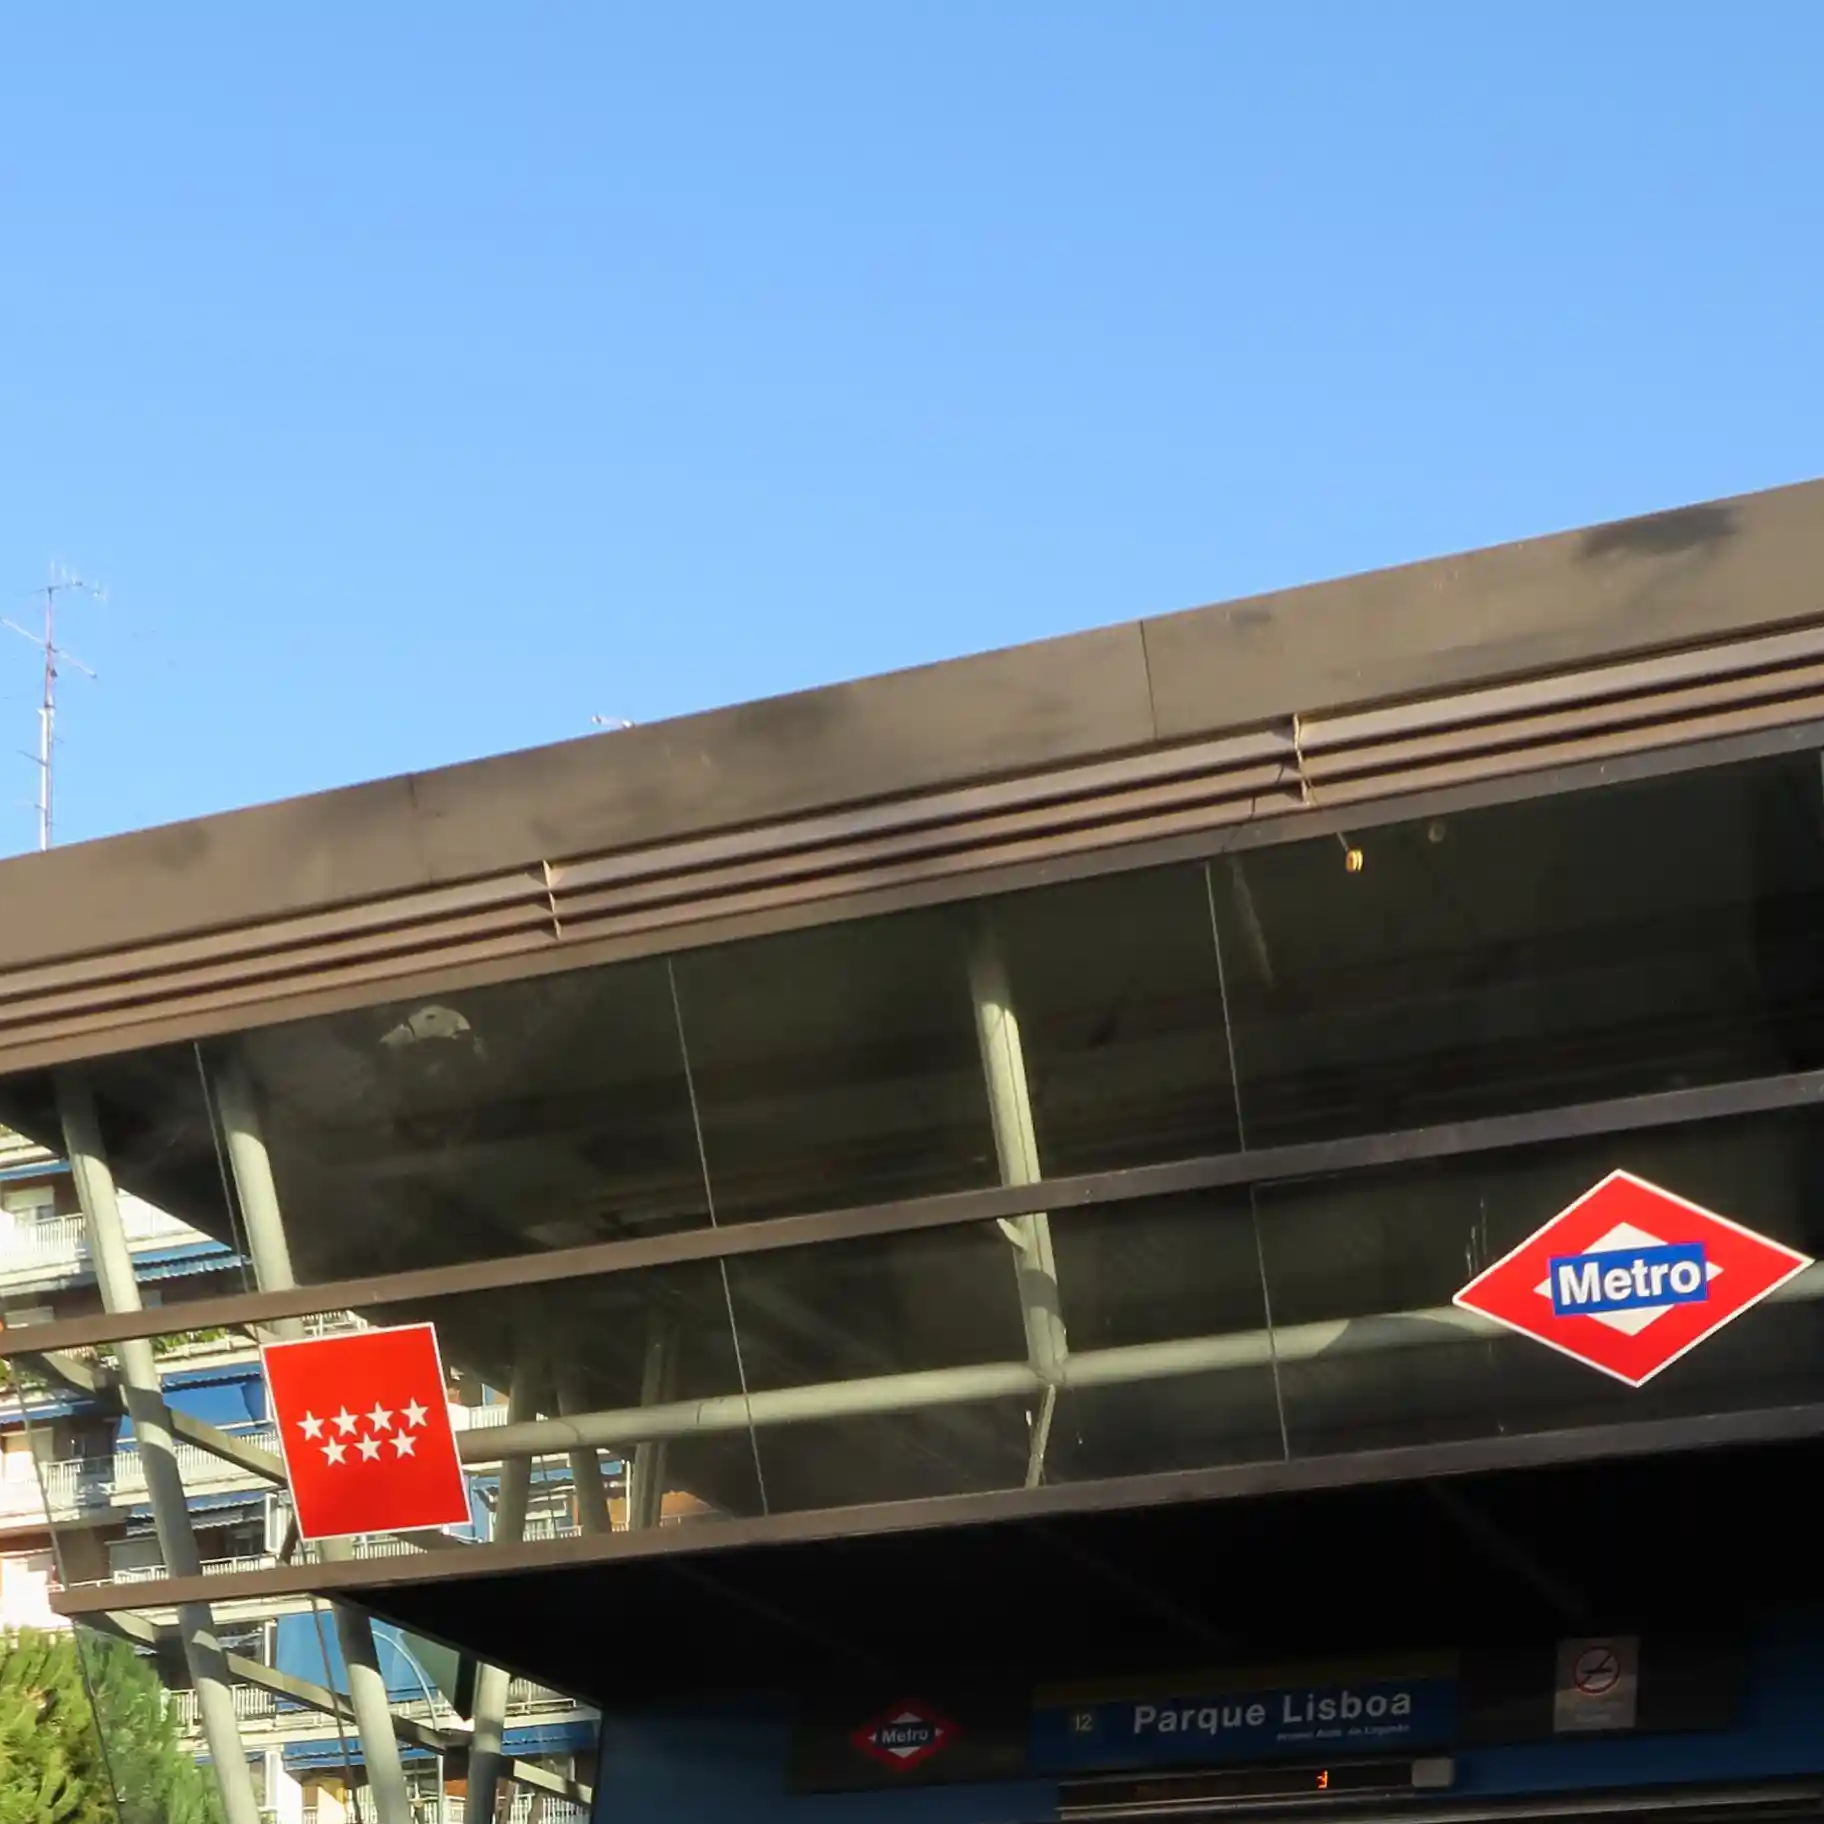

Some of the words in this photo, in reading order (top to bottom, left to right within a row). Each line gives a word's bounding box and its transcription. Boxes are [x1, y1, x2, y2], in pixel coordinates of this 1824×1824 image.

[1557, 1257, 1702, 1307] Metro
[1074, 1712, 1094, 1732] 12
[1132, 1703, 1267, 1736] Parque
[1281, 1689, 1413, 1725] Lisboa
[881, 1727, 929, 1744] Metro
